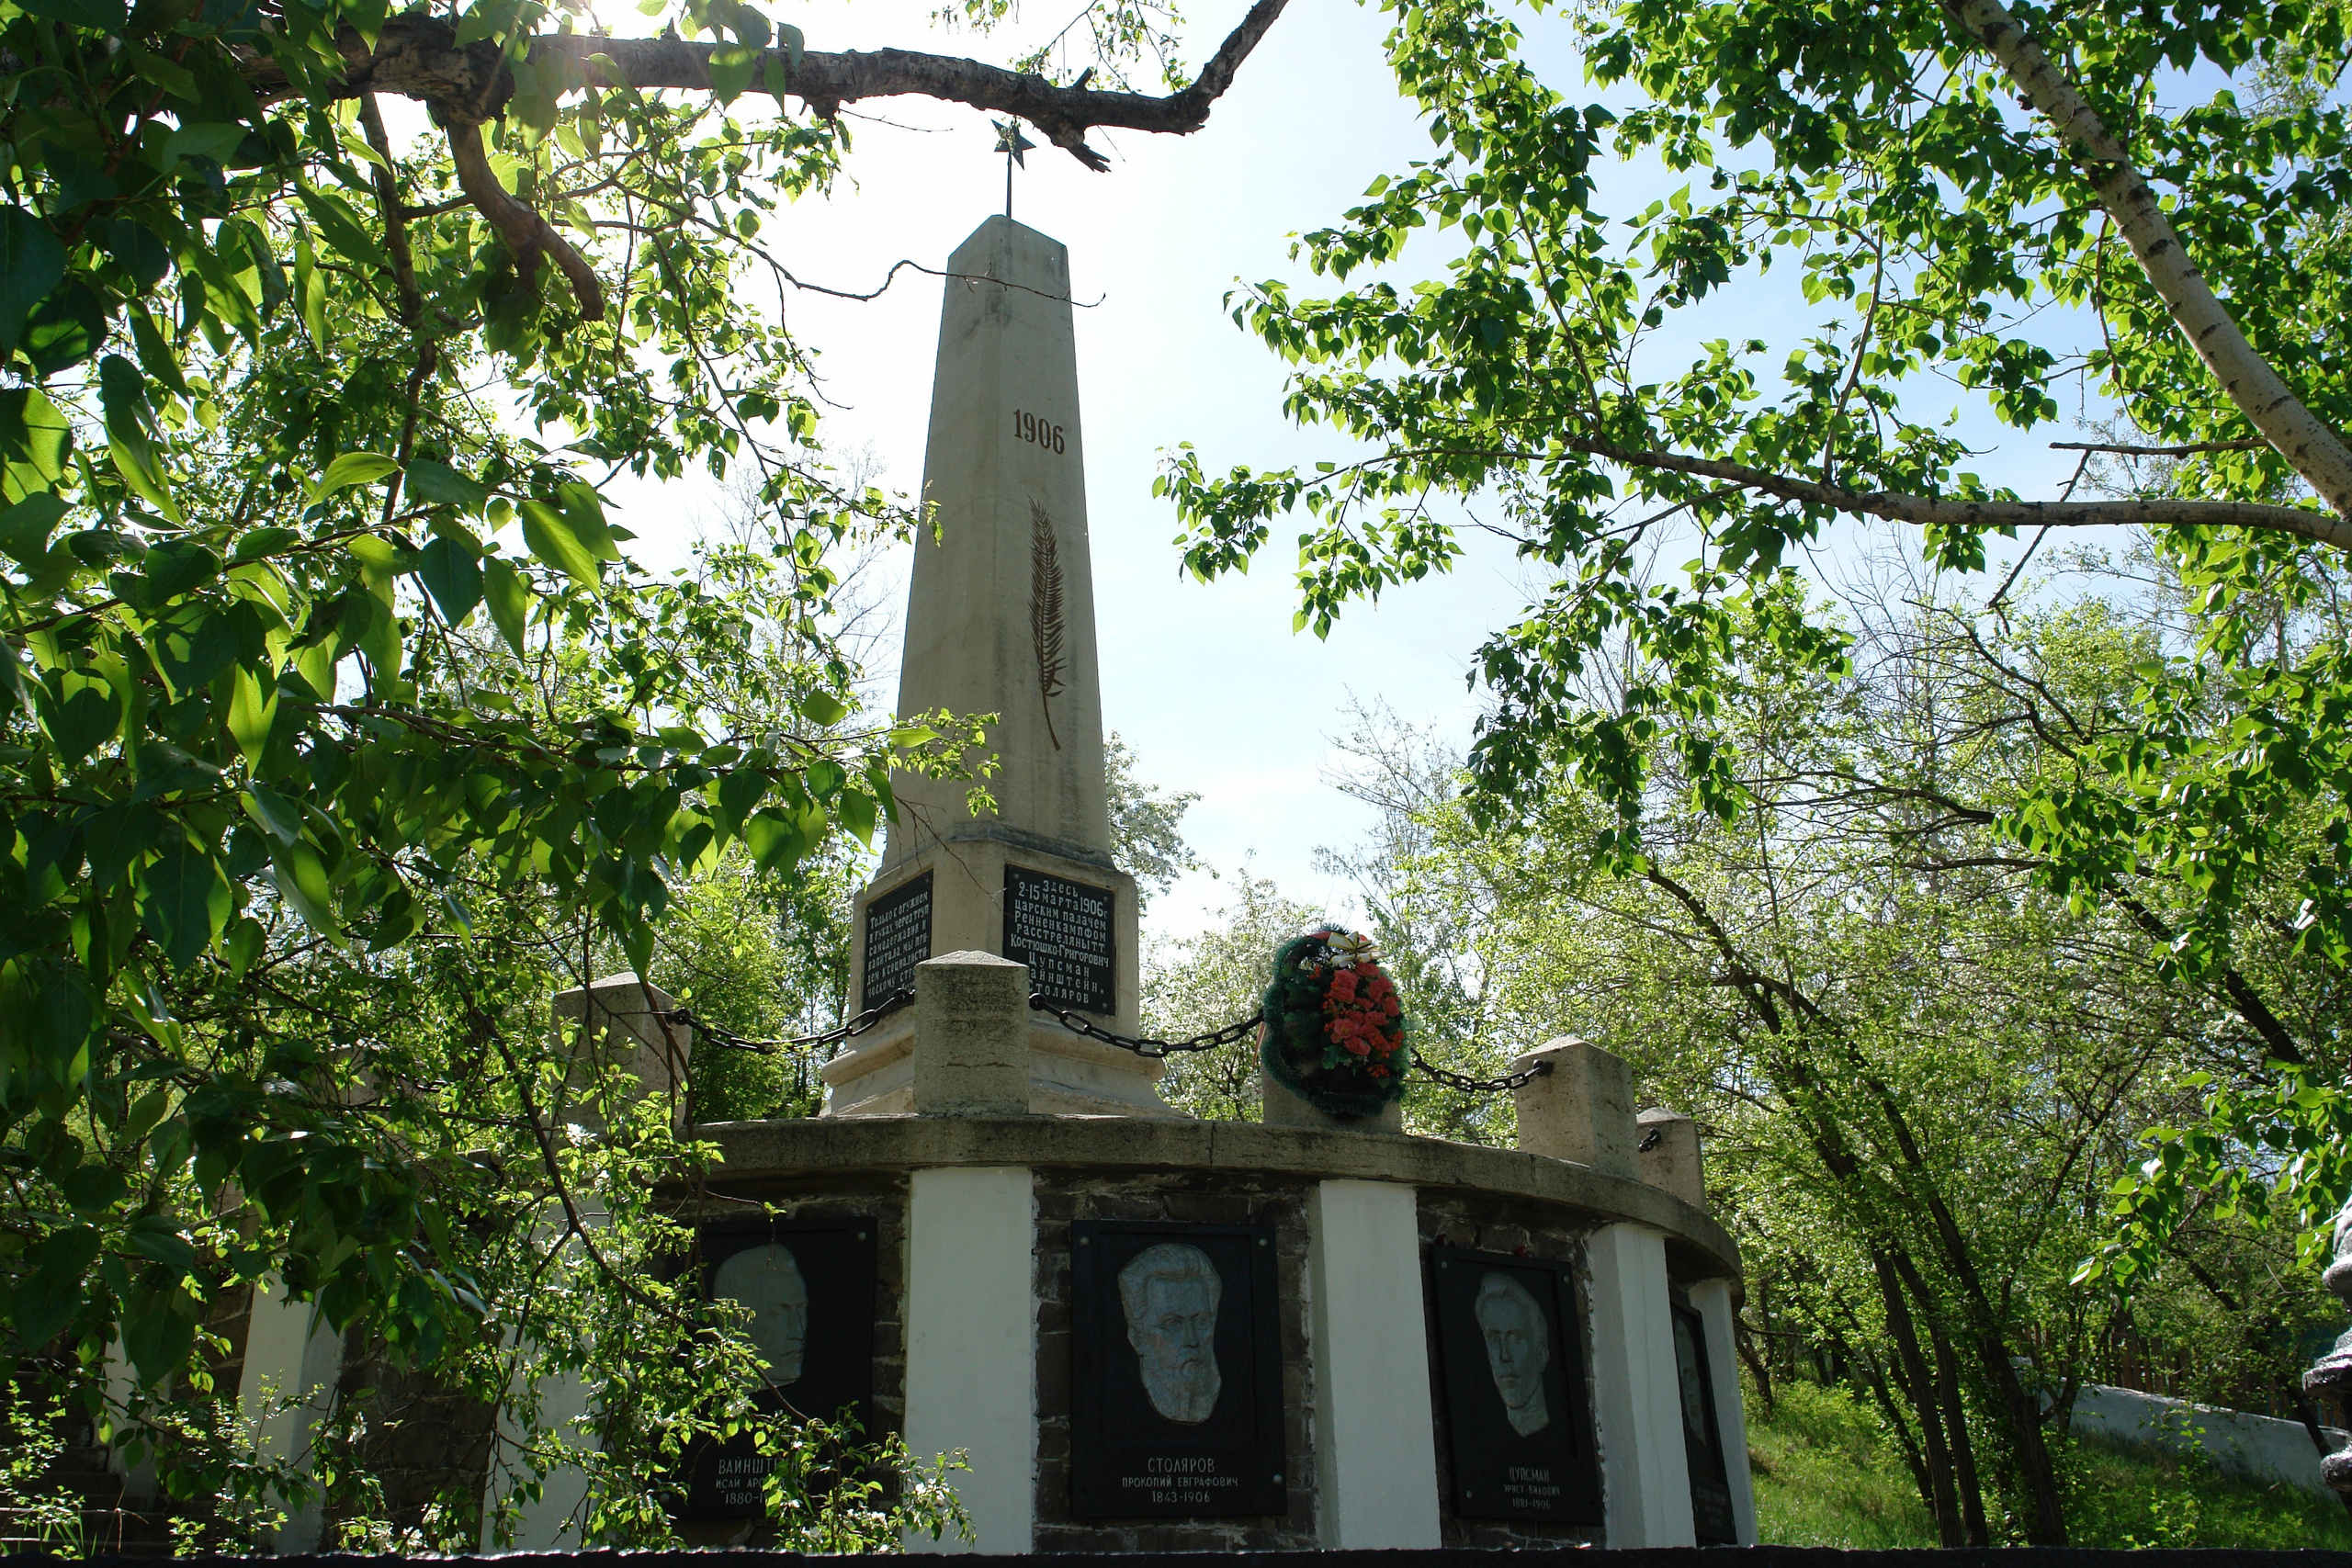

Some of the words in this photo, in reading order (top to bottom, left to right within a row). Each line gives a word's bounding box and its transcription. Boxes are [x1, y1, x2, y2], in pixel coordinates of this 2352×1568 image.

[1012, 408, 1066, 456] 1906
[1043, 879, 1079, 898] Здесь
[1018, 881, 1041, 901] 2-15
[1042, 893, 1080, 911] марта
[1080, 897, 1103, 918] 1906
[895, 915, 912, 931] через
[913, 904, 930, 921] труп
[1014, 898, 1059, 919] царским
[1062, 910, 1107, 931] палачем
[1014, 909, 1107, 942] Ренненкампфом
[902, 939, 914, 953] мы
[1011, 932, 1110, 968] Костюшко-Григорович
[1029, 951, 1091, 978] Цупсман
[718, 1456, 798, 1475] ВАЙНШТН
[1148, 1457, 1216, 1473] СТОЛЯРОВ
[1509, 1466, 1551, 1483] ЦУПСМАН
[715, 1475, 741, 1490] ИСАЙ
[1122, 1474, 1172, 1488] ПРОКОПИЙ
[1177, 1476, 1239, 1488] ЕВГРАФОВИЧ
[1502, 1483, 1525, 1494] ЭРНСТ
[1151, 1489, 1211, 1504] 1843-1906
[1512, 1496, 1552, 1510] 1881-1906
